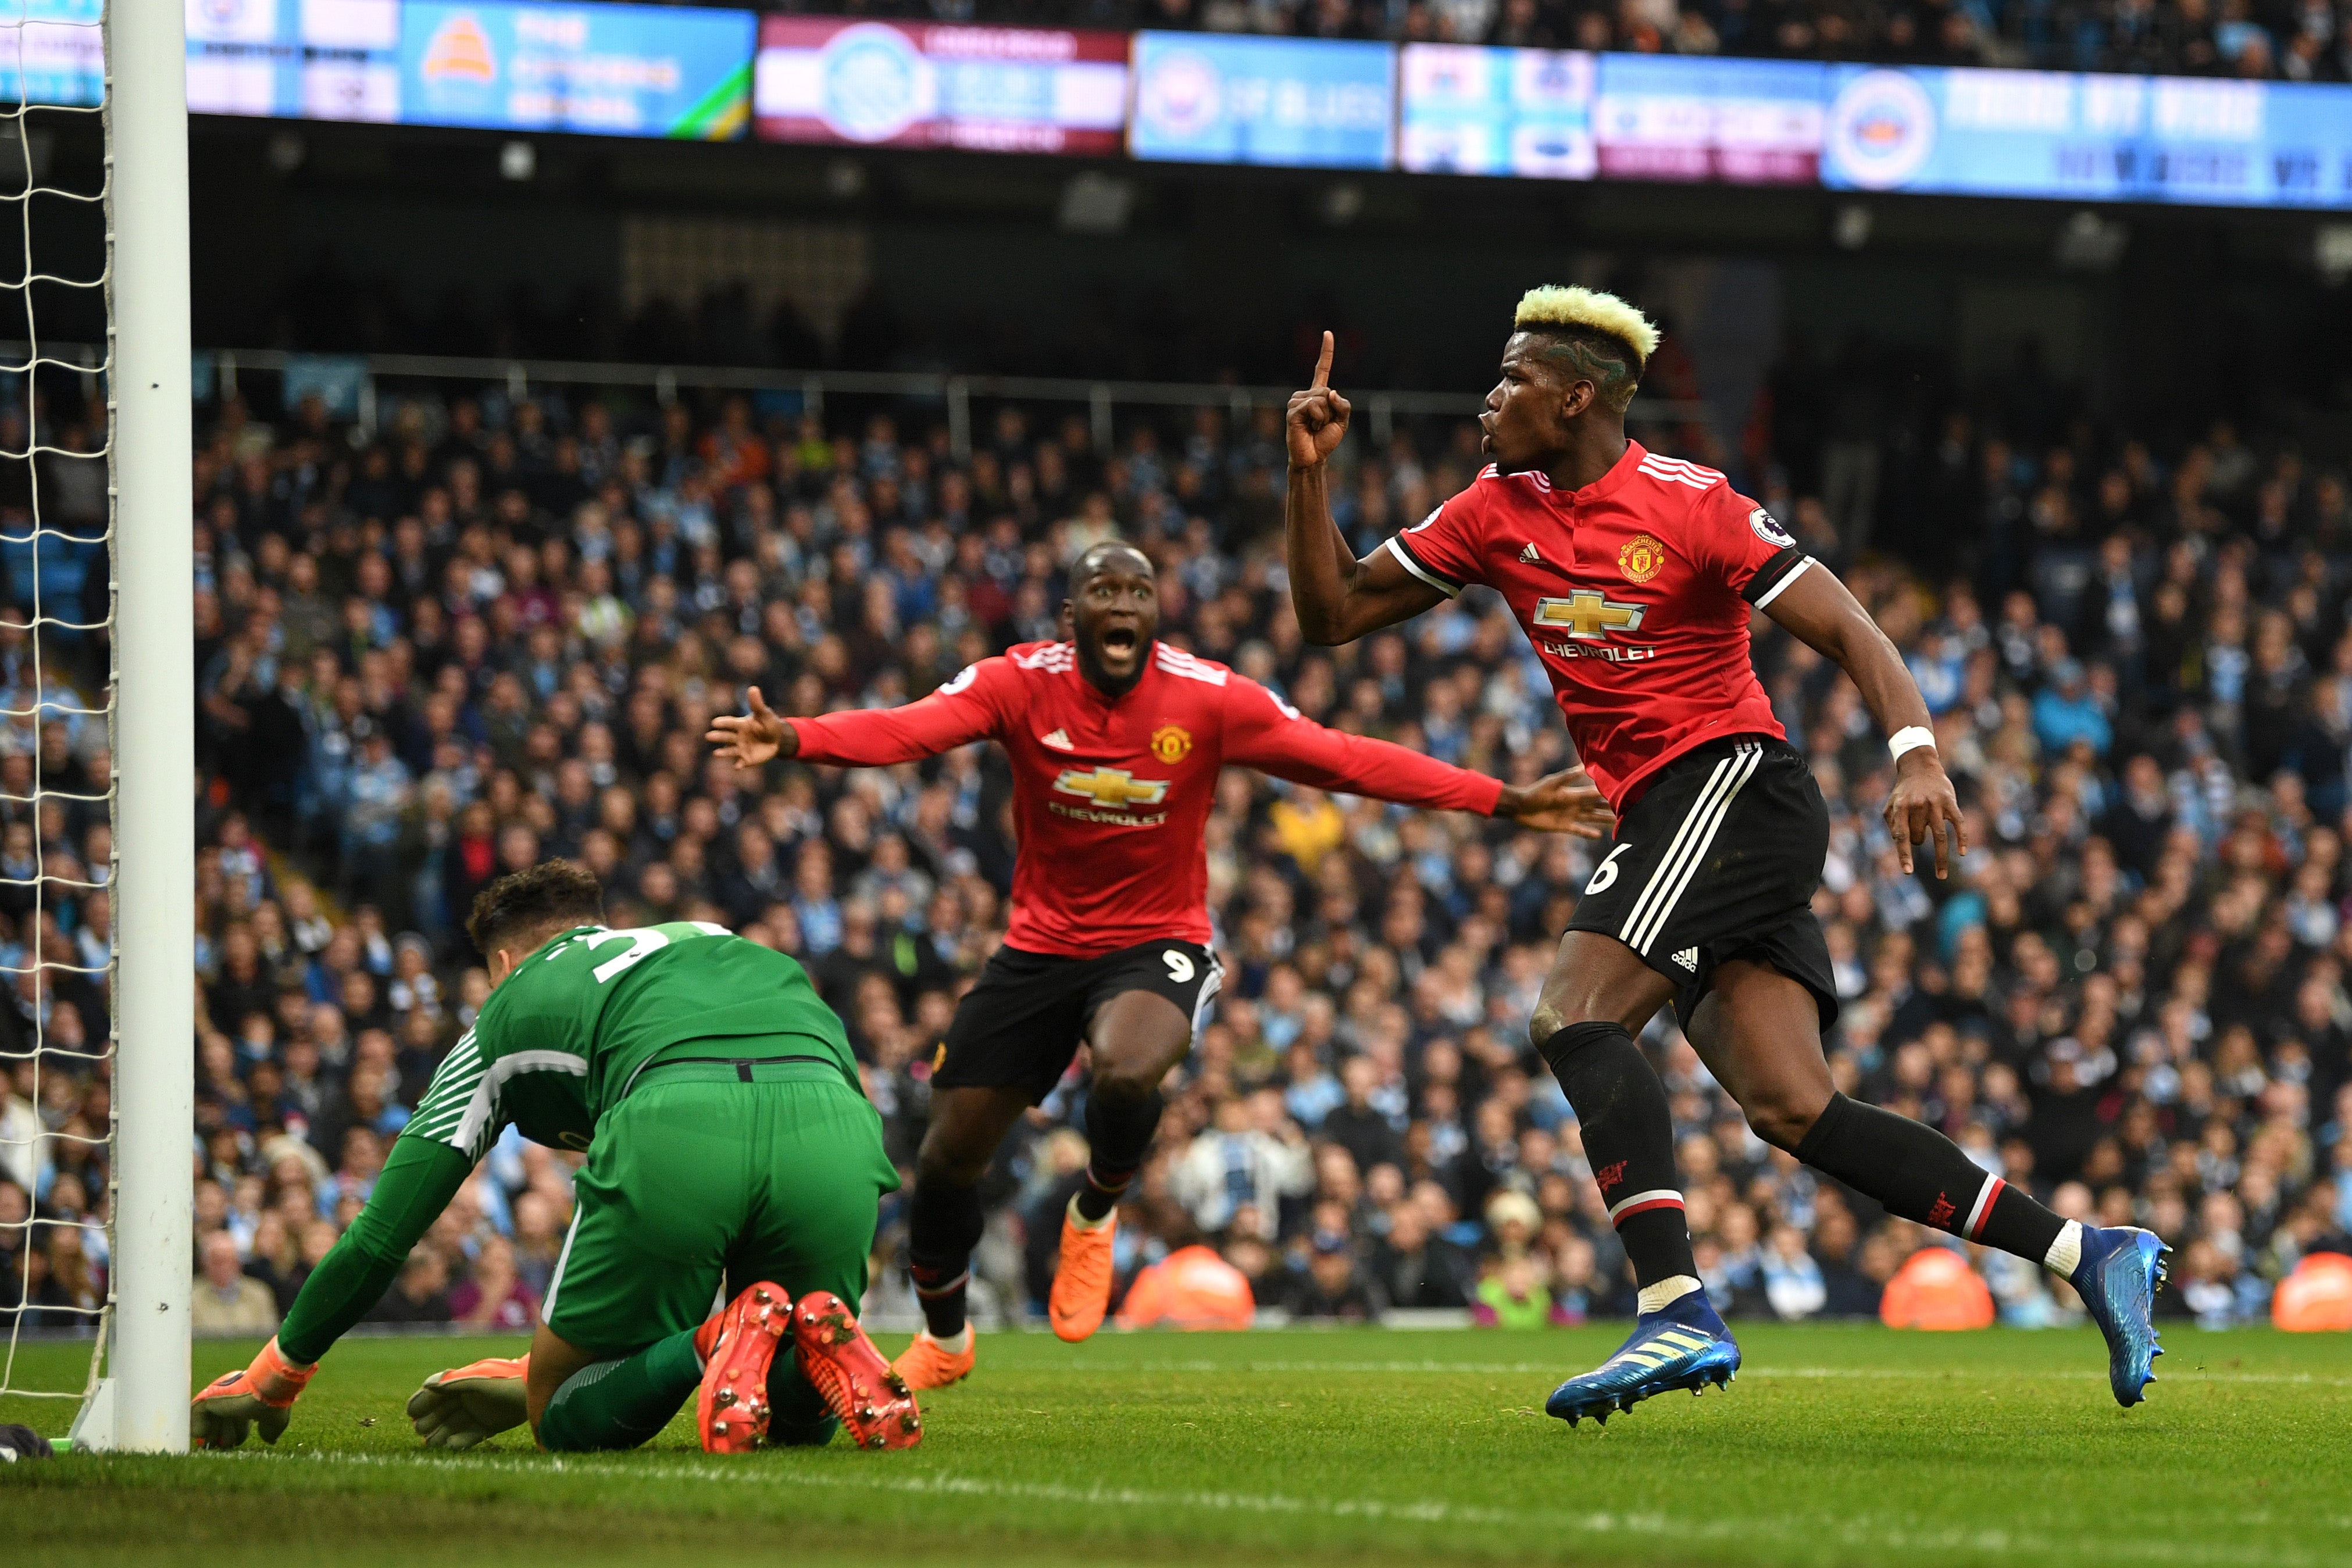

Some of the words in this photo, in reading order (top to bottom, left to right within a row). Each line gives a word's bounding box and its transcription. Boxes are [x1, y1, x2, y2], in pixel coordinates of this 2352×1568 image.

[1624, 538, 1661, 554] MANCHESTER
[1628, 570, 1654, 580] UNITED
[1544, 640, 1657, 662] CHEVROLET
[1584, 843, 1633, 895] 6
[1162, 949, 1195, 983] 9
[1671, 953, 1696, 973] adida
